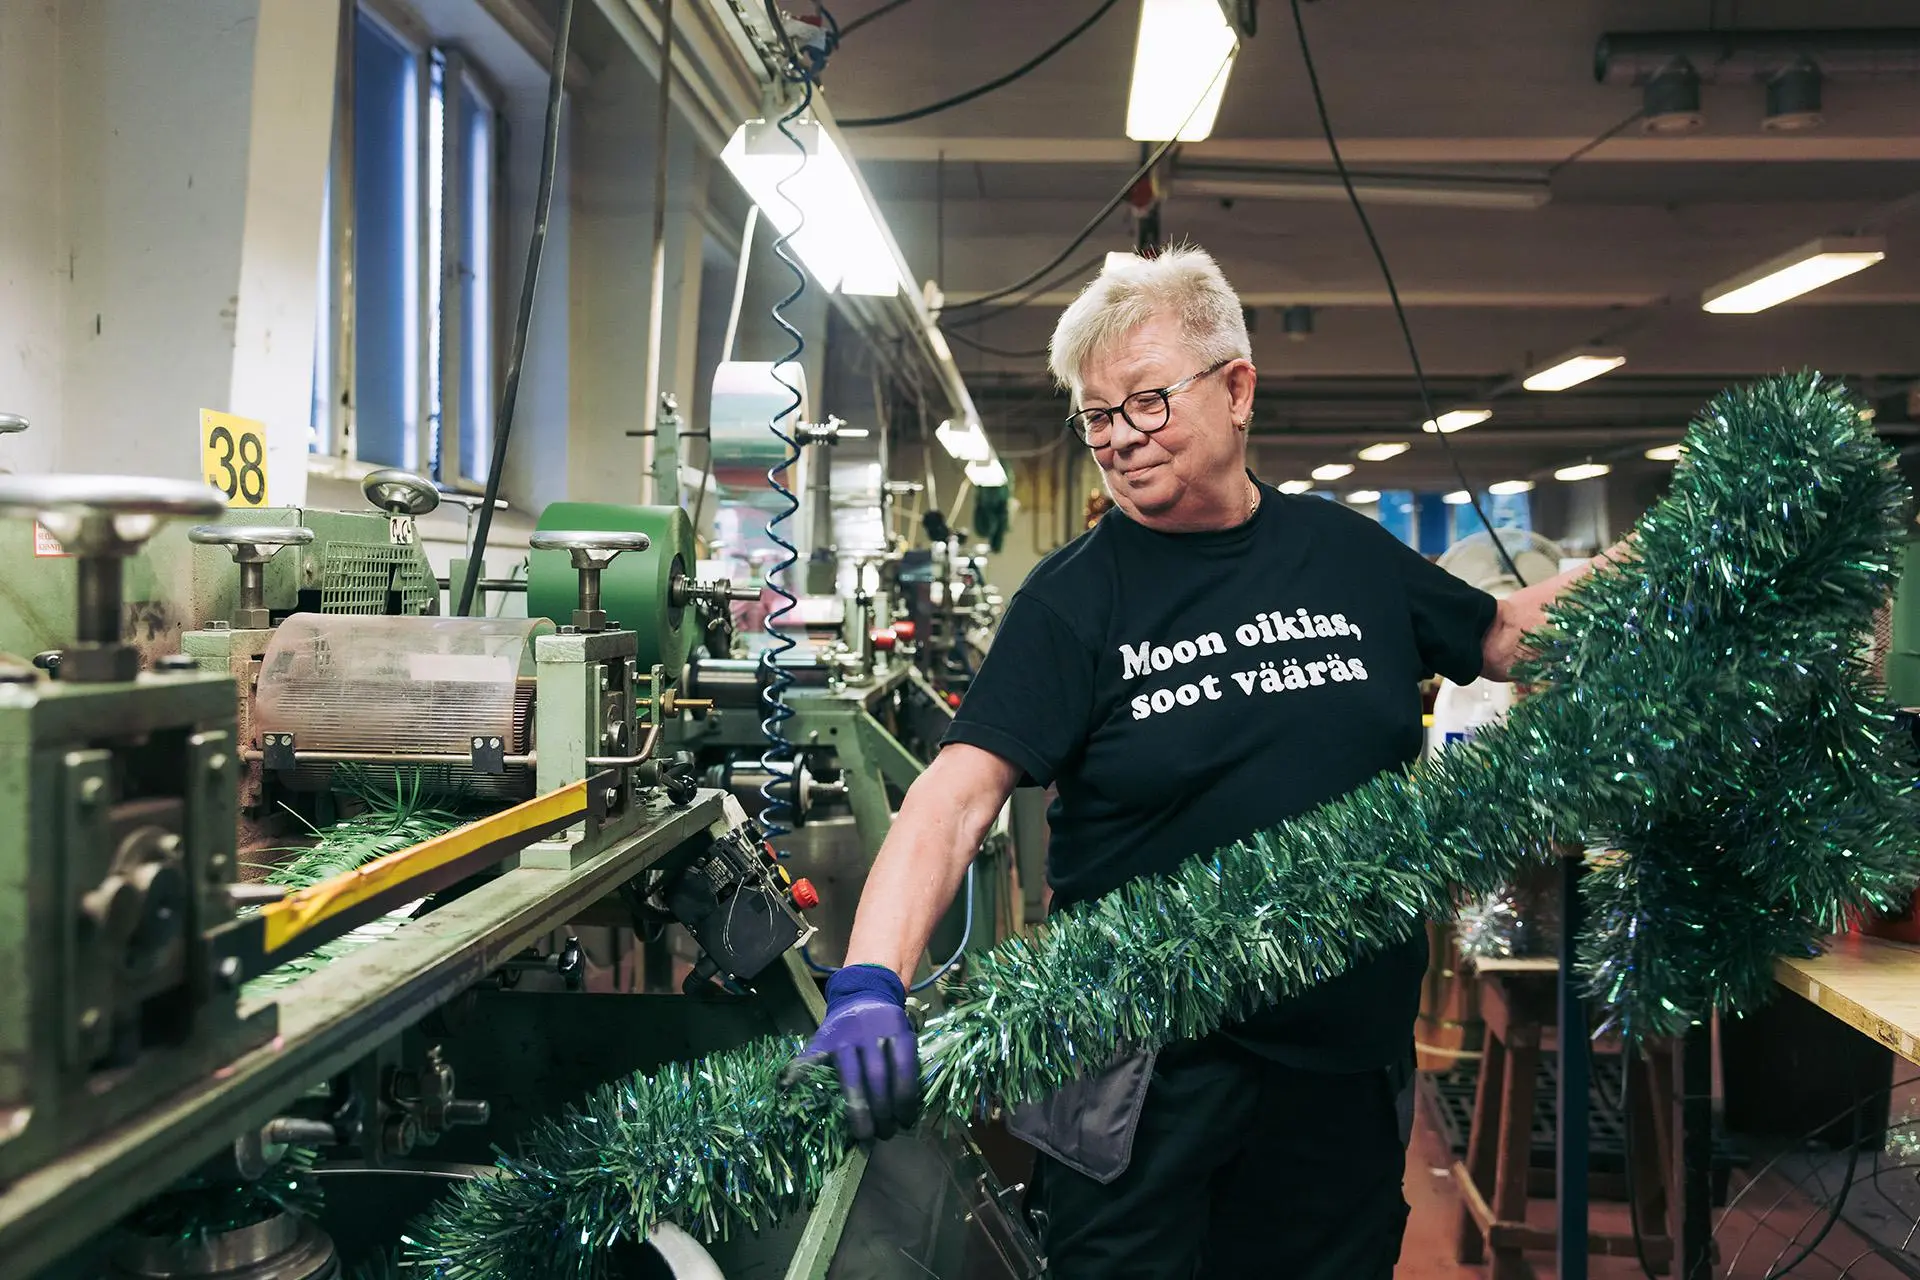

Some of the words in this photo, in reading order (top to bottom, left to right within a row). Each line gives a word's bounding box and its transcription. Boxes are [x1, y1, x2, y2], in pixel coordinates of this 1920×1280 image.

[209, 426, 265, 505] 38
[1118, 631, 1227, 680] Moon
[1235, 607, 1362, 647] oikias,
[1130, 674, 1223, 721] soot
[1230, 653, 1369, 696] vääräs
